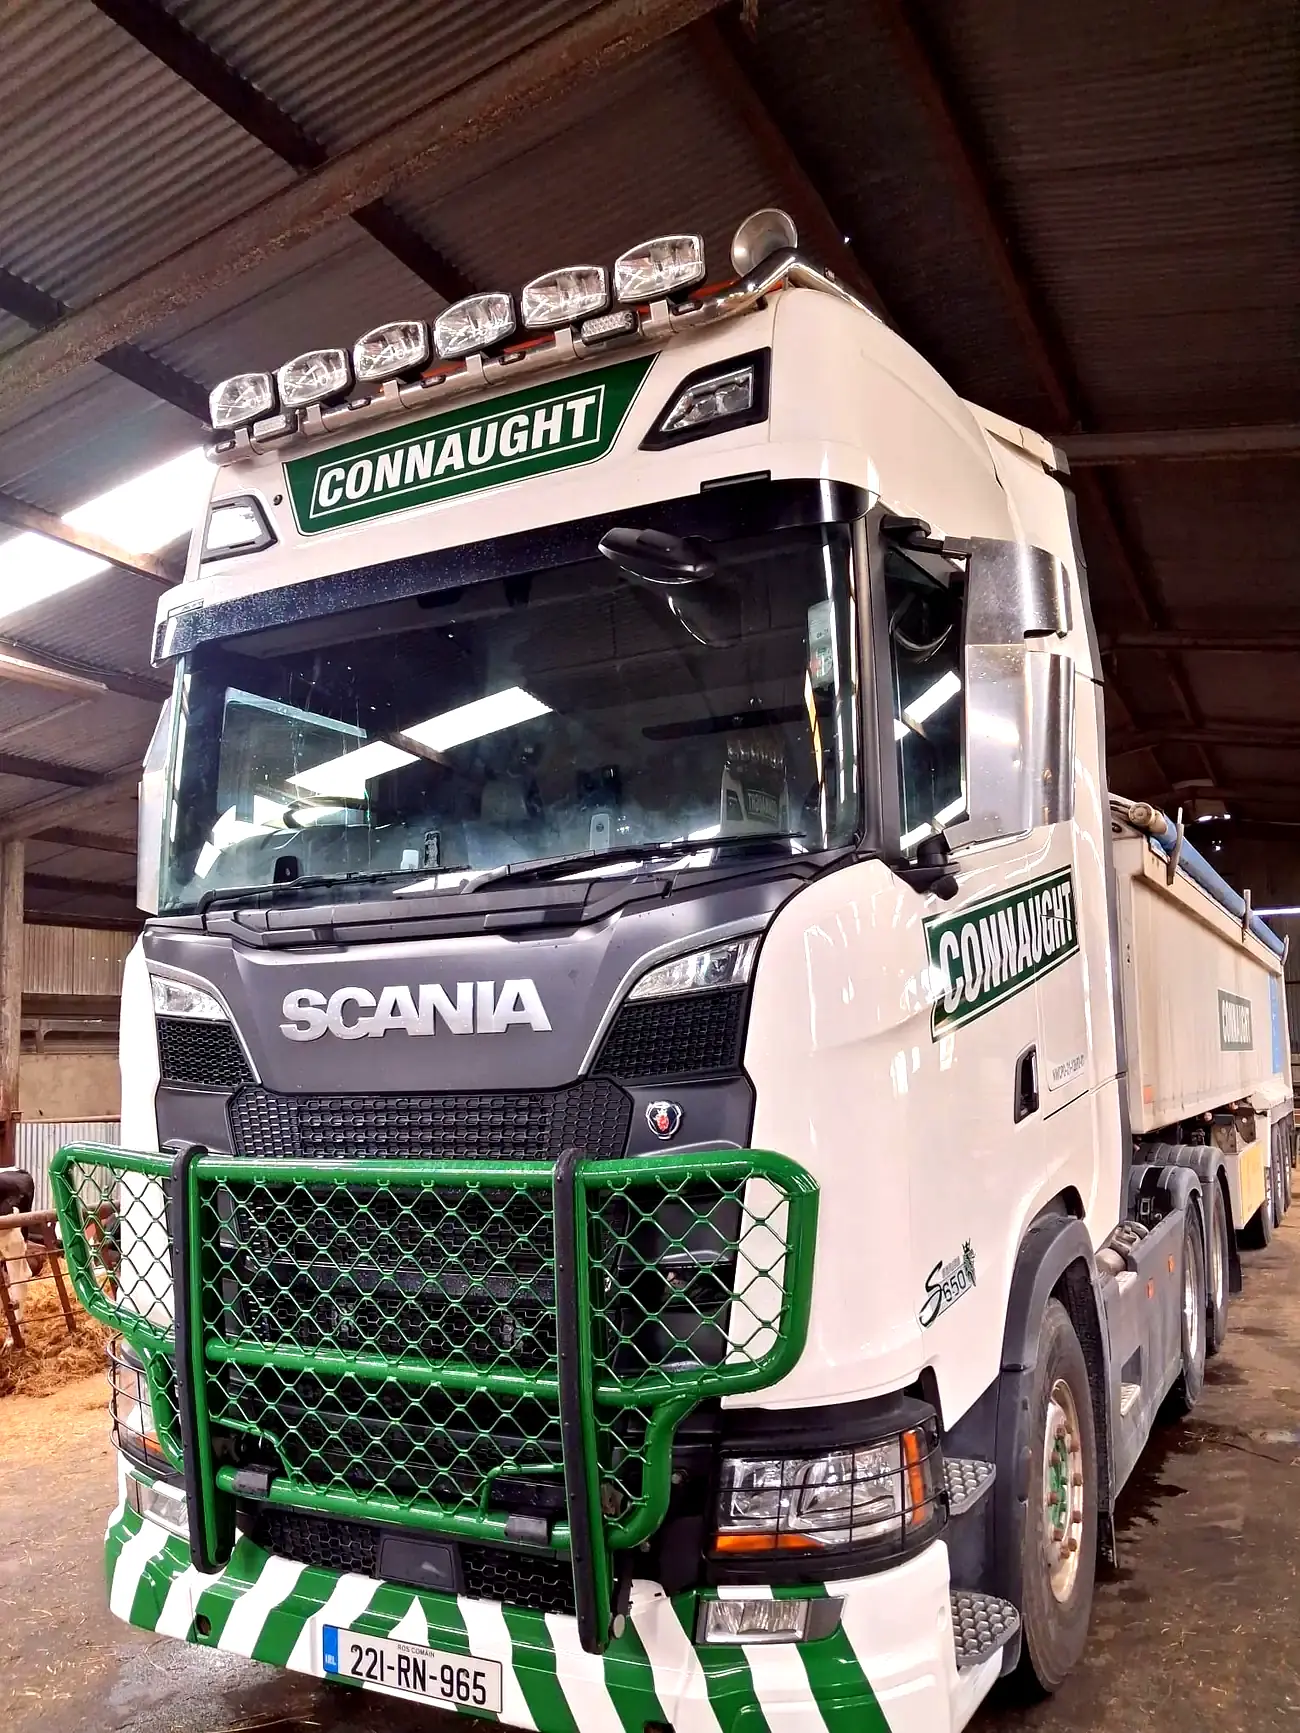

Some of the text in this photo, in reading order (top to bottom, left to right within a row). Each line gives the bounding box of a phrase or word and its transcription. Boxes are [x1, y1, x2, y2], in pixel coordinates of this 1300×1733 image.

[317, 395, 598, 508] CONNAUGHT
[938, 881, 1075, 1014] CONNAUGHT
[278, 979, 553, 1042] SCANIA
[325, 1653, 337, 1666] IRL
[350, 1644, 487, 1705] 221-RN-965
[396, 1644, 411, 1653] ROS
